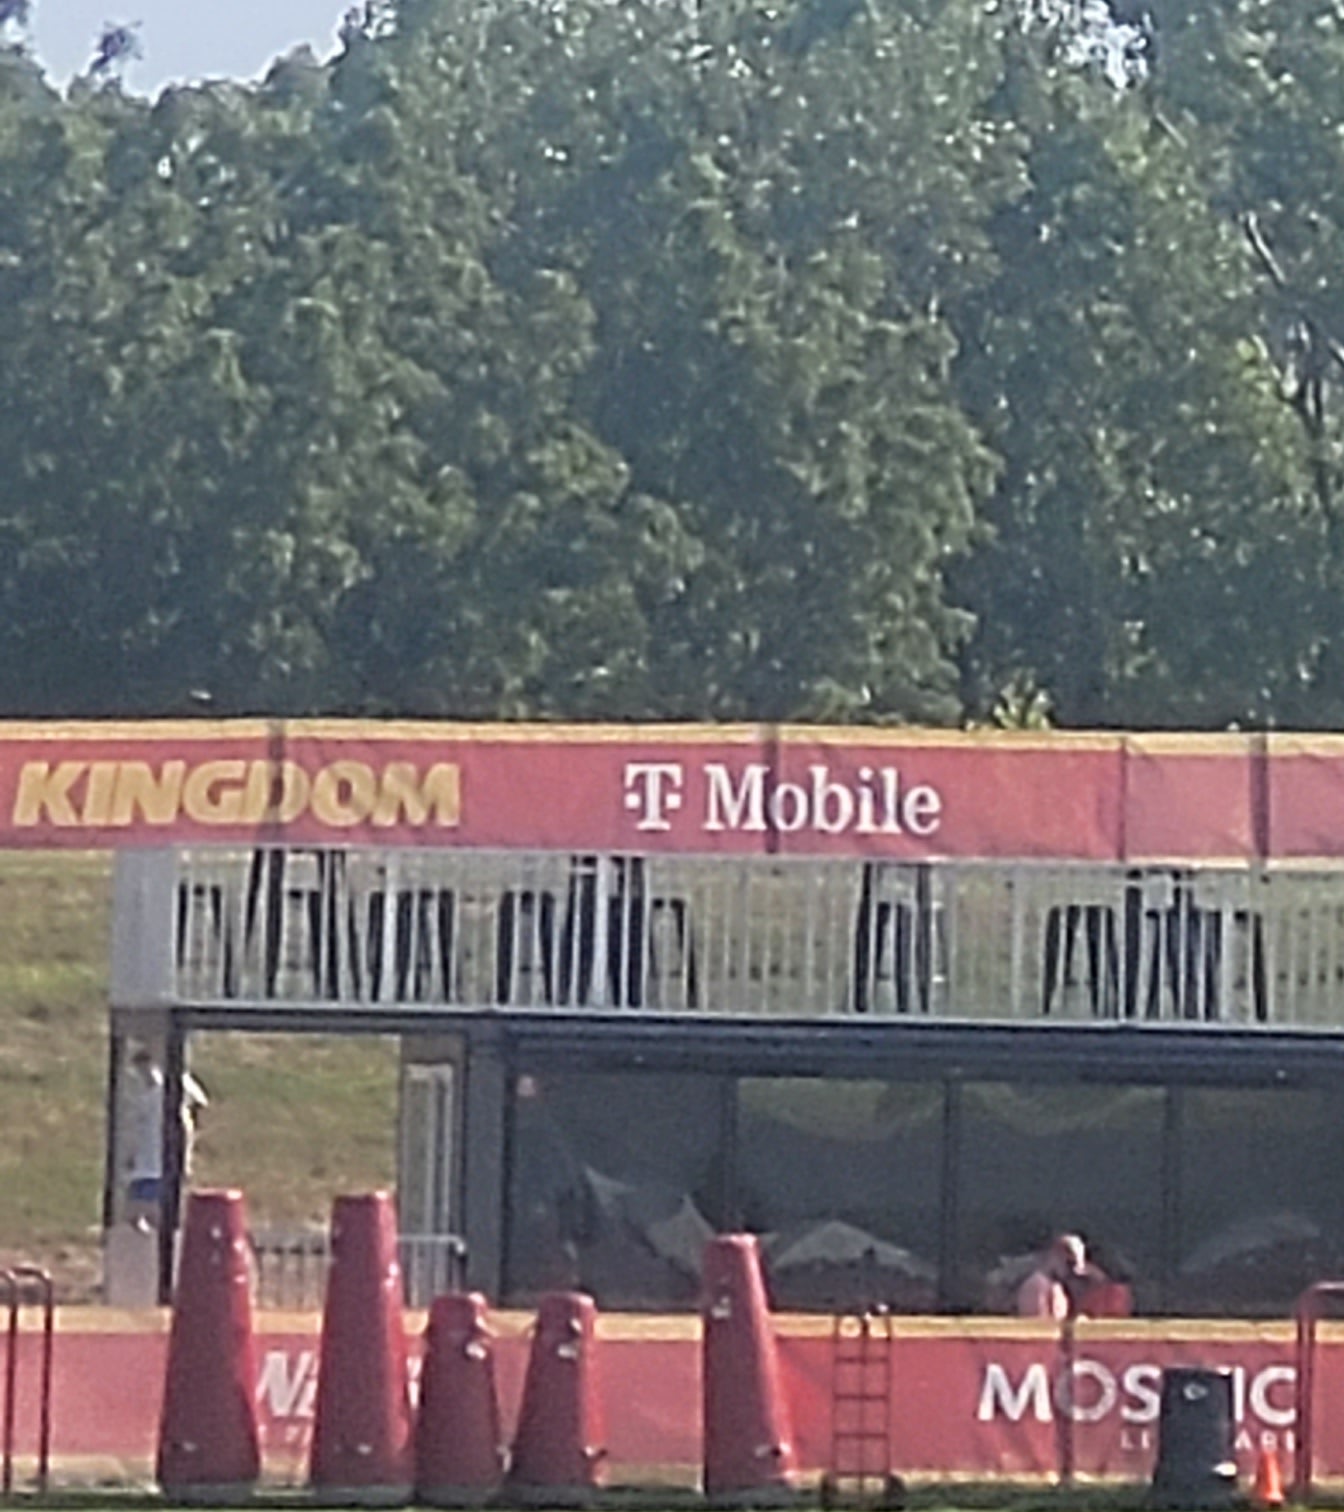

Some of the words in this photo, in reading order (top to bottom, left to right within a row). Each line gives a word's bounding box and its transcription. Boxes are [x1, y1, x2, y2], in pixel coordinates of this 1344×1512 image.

[12, 760, 461, 827] KINGDOM
[625, 763, 682, 831] T
[703, 763, 943, 835] Mobile
[977, 1360, 1298, 1426] MOSIC
